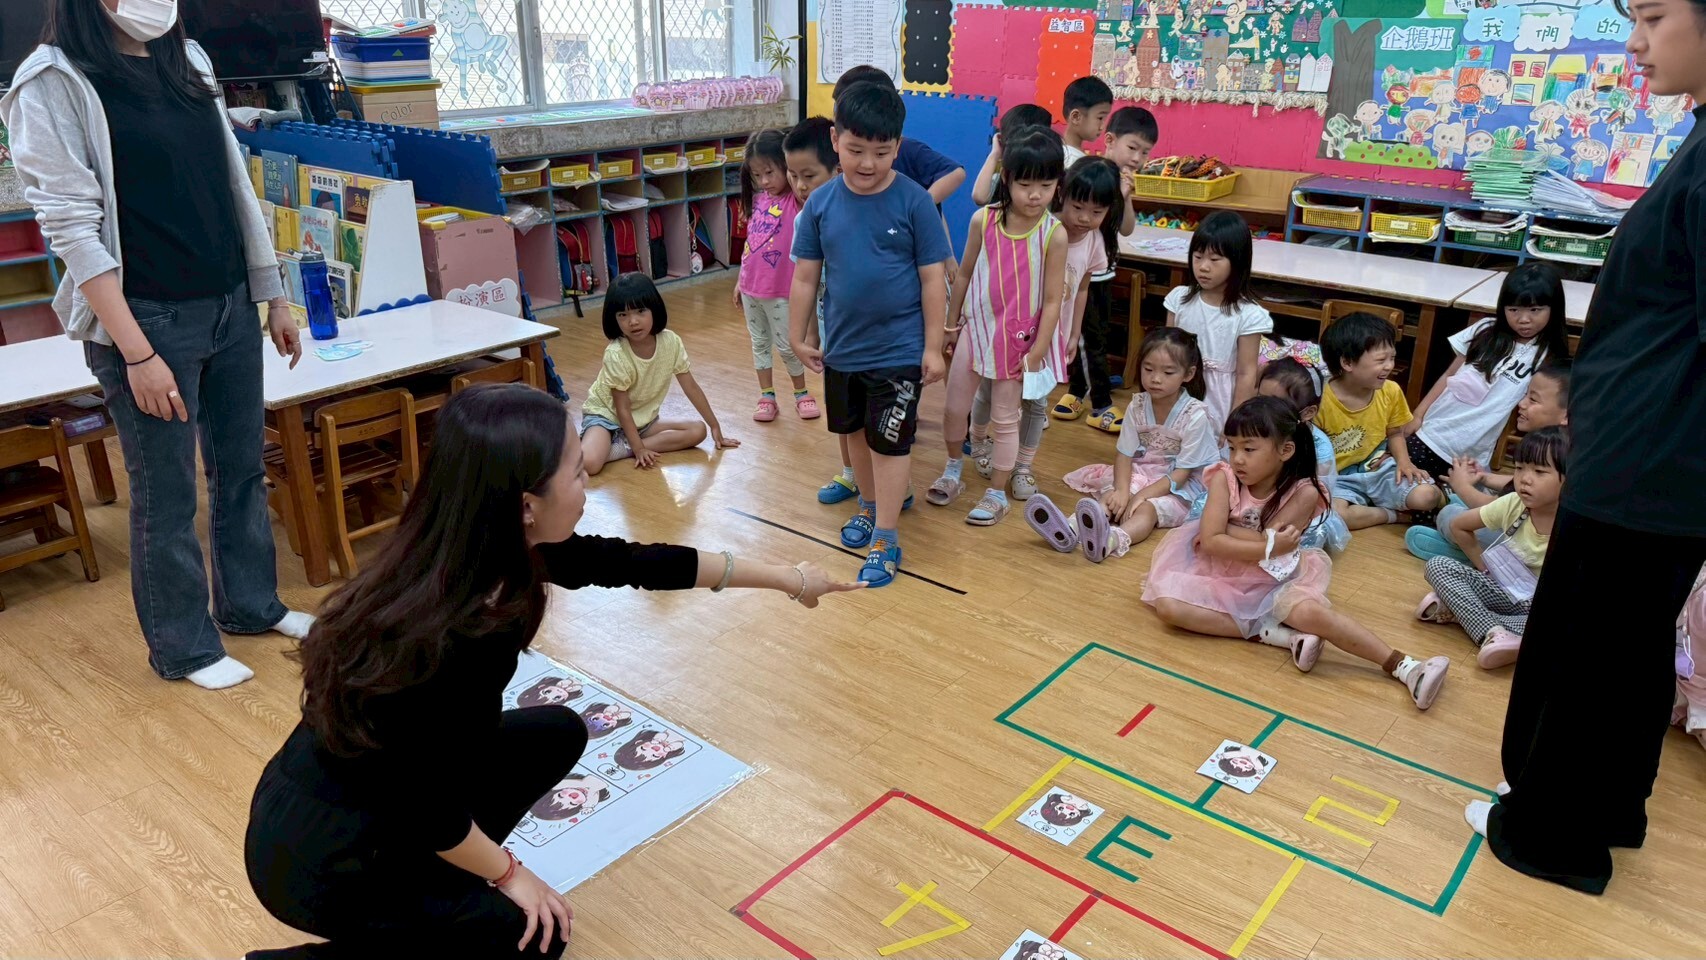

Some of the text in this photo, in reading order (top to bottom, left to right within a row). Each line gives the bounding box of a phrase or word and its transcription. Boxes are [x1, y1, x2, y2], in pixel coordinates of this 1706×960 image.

[1051, 19, 1083, 32] 益智區
[1382, 27, 1453, 49] 企鵝班
[380, 101, 413, 124] Color
[854, 520, 872, 534] BEAR
